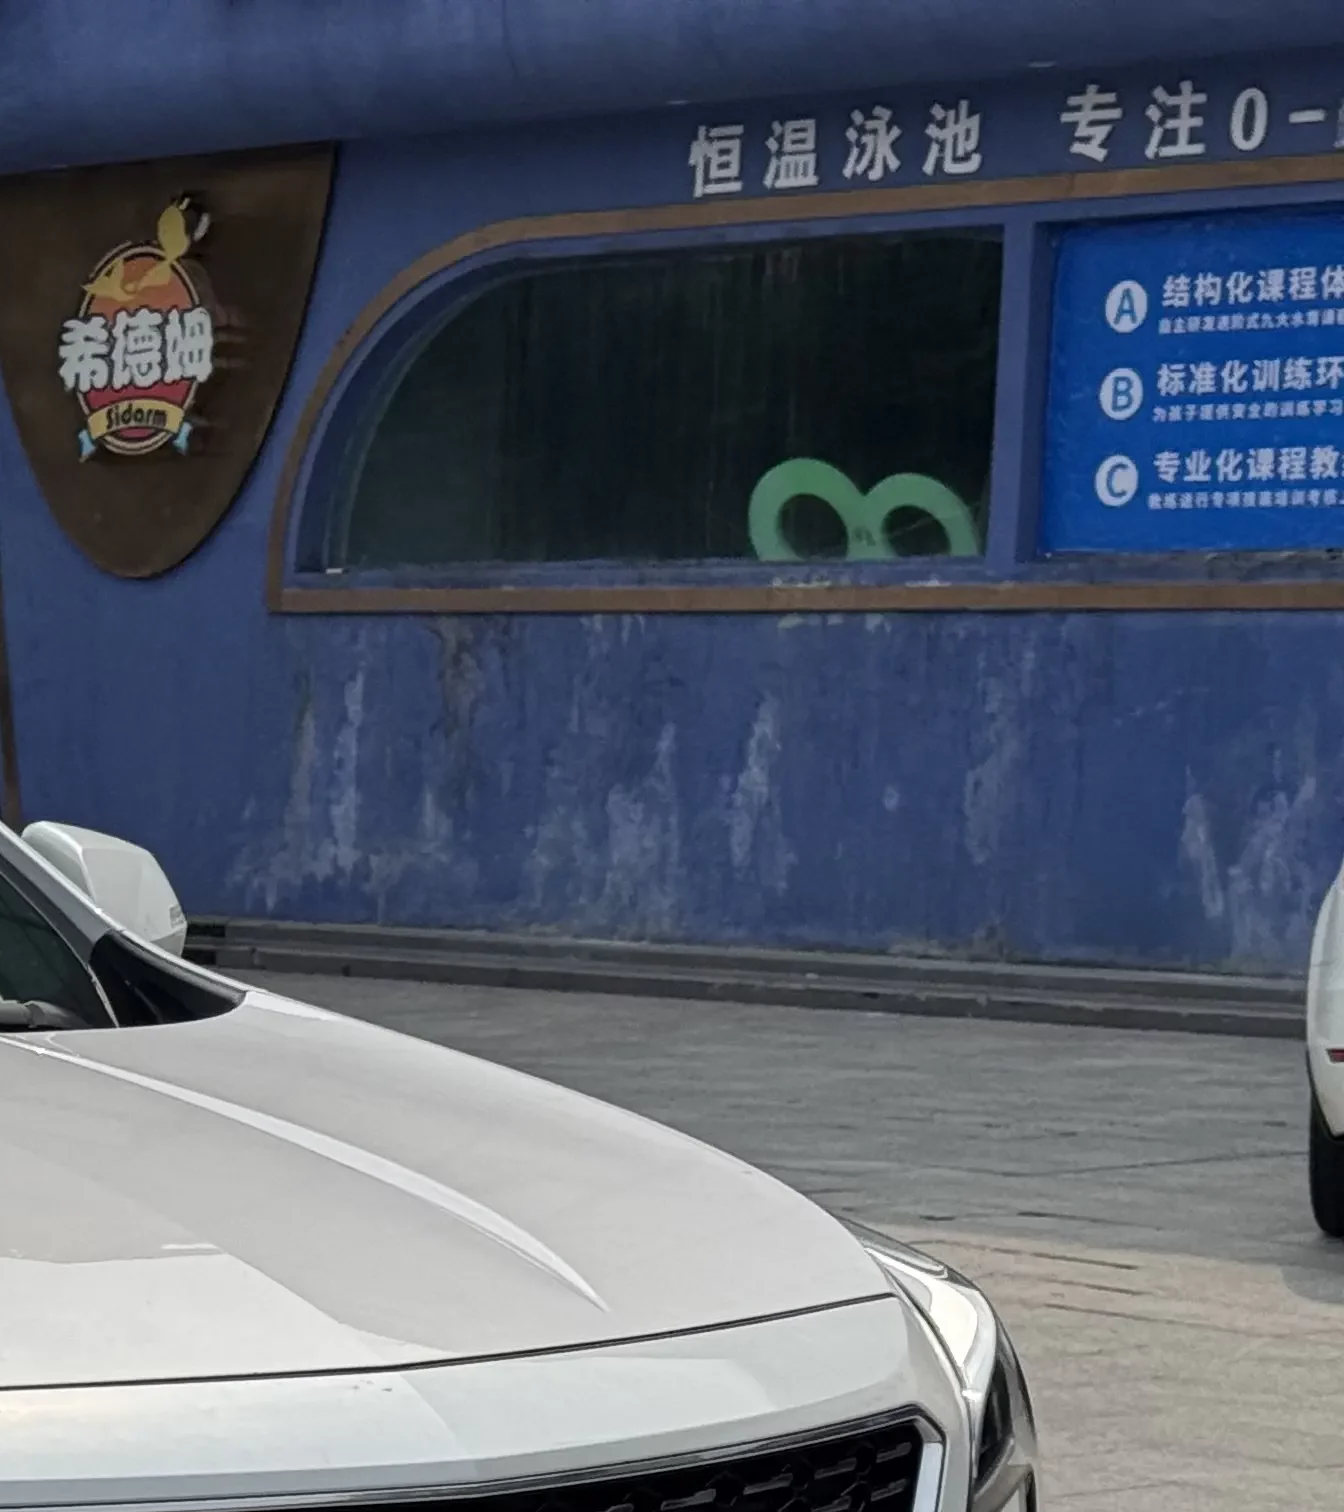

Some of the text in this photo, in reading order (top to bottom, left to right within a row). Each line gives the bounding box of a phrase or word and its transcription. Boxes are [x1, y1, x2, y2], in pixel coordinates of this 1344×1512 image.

[689, 80, 1344, 198] 恒温泳池 专注0-
[1162, 264, 1344, 308] 结构化课程体
[58, 307, 213, 392] 希德姆
[1156, 355, 1344, 396] 标准化训练环
[1154, 445, 1344, 483] 专业化课程教
